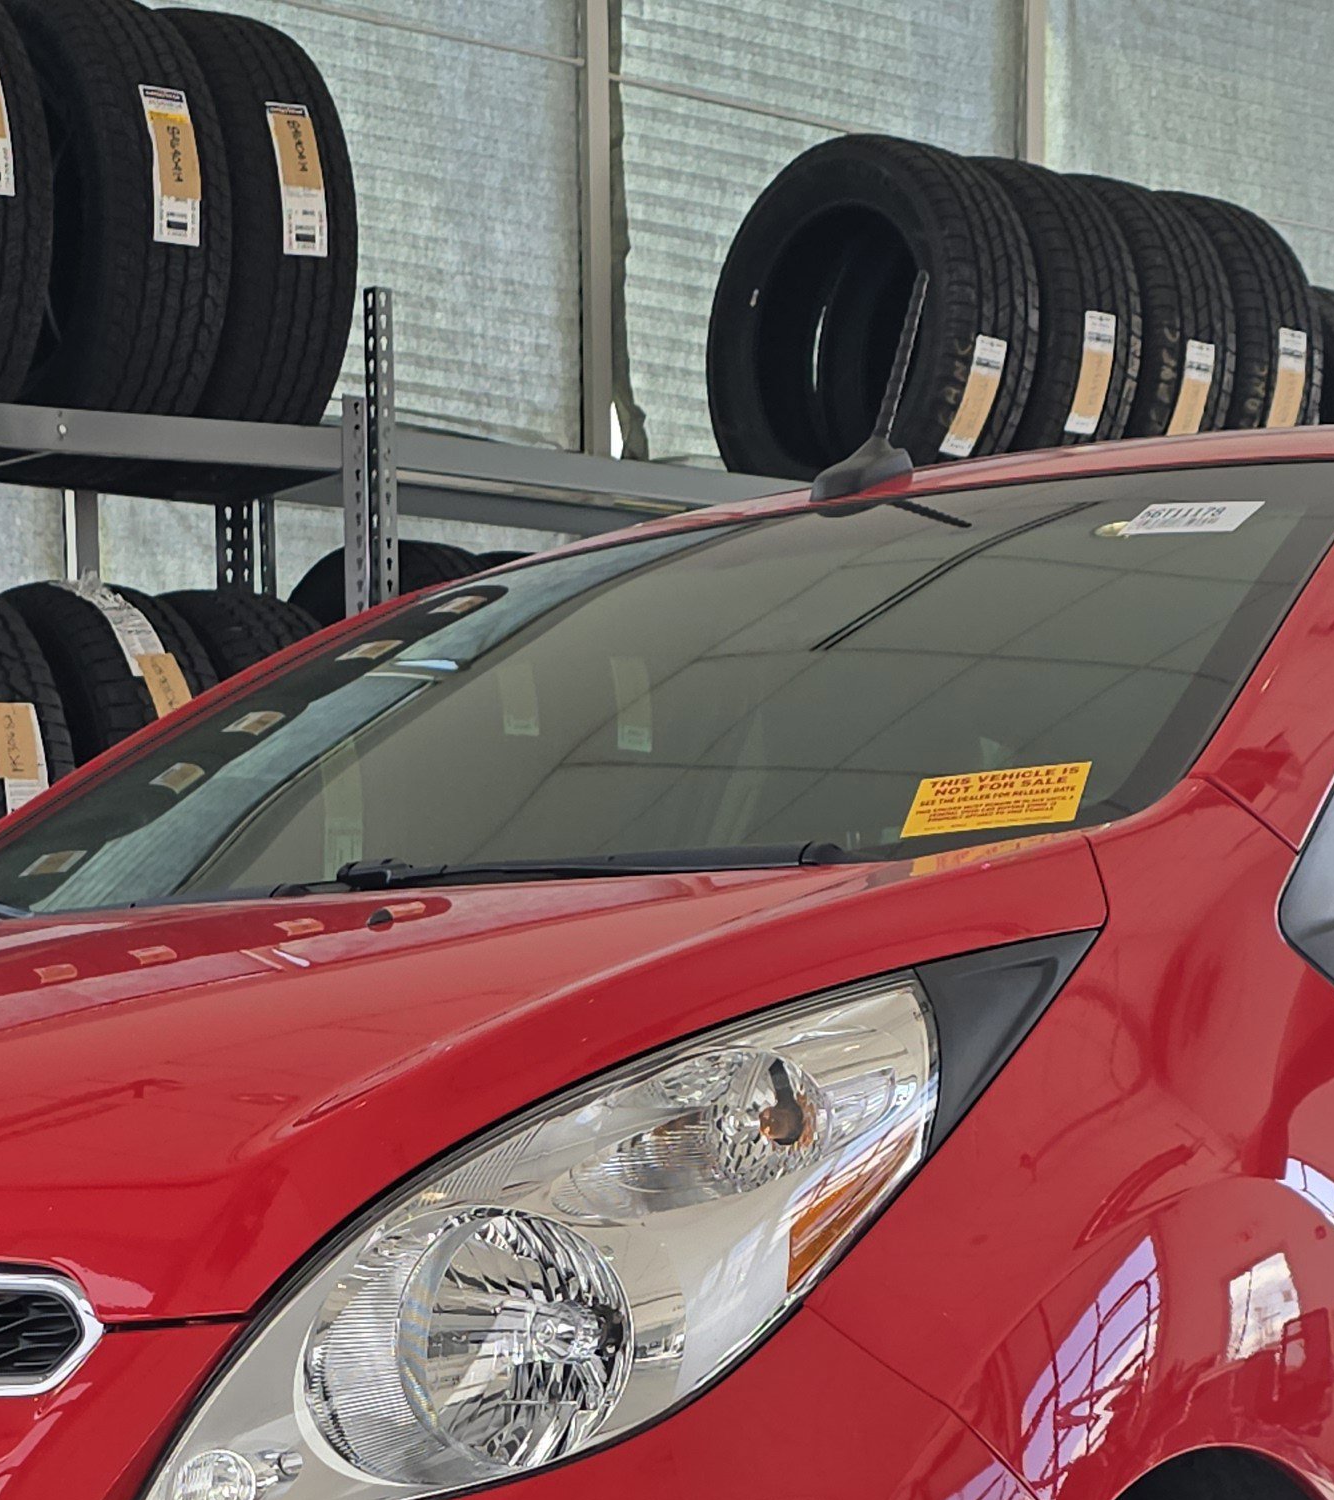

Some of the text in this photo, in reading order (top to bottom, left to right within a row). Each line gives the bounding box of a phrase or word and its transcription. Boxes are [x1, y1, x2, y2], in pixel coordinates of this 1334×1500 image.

[930, 766, 1080, 789] THIS VEHICLE IS
[934, 776, 1067, 797] NOT FOR SALE
[939, 796, 955, 805] THE
